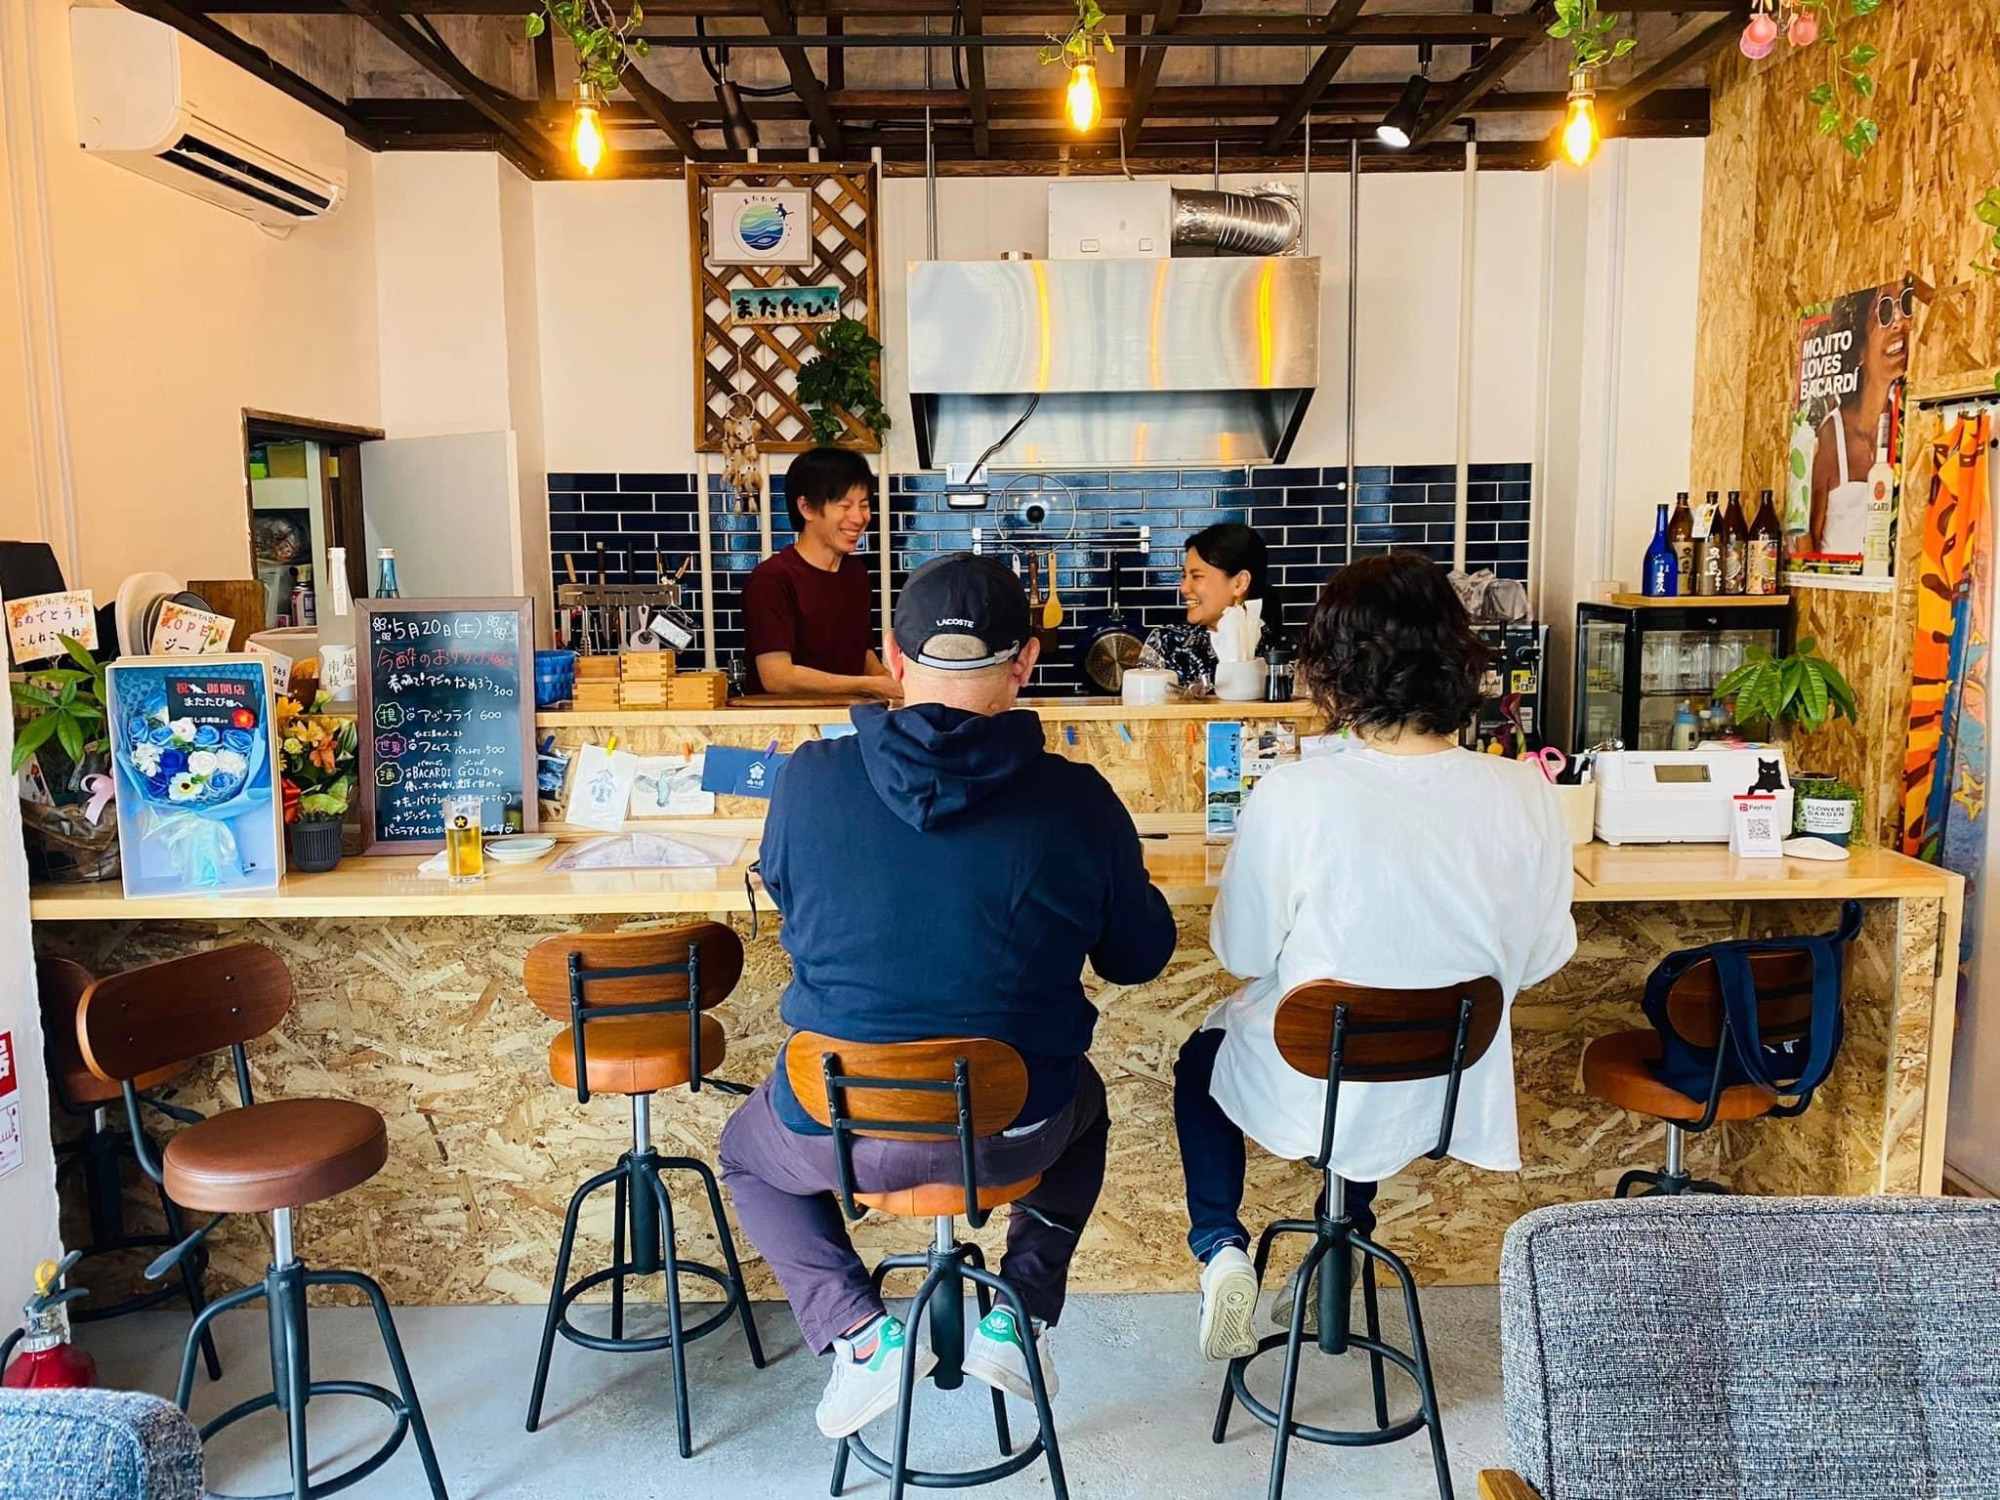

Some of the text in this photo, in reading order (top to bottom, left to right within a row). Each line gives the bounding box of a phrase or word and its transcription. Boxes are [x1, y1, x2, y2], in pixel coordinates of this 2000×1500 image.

[736, 296, 831, 320] またたび
[1802, 329, 1853, 360] MOJITO
[1801, 353, 1842, 380] LOVES
[935, 617, 975, 629] LACOSTE
[493, 685, 514, 697] 300
[479, 710, 502, 721] 600
[418, 741, 452, 754] フムス
[485, 744, 506, 755] 500
[412, 765, 491, 780] BACARDI GOLD
[1748, 804, 1773, 812] PayPay
